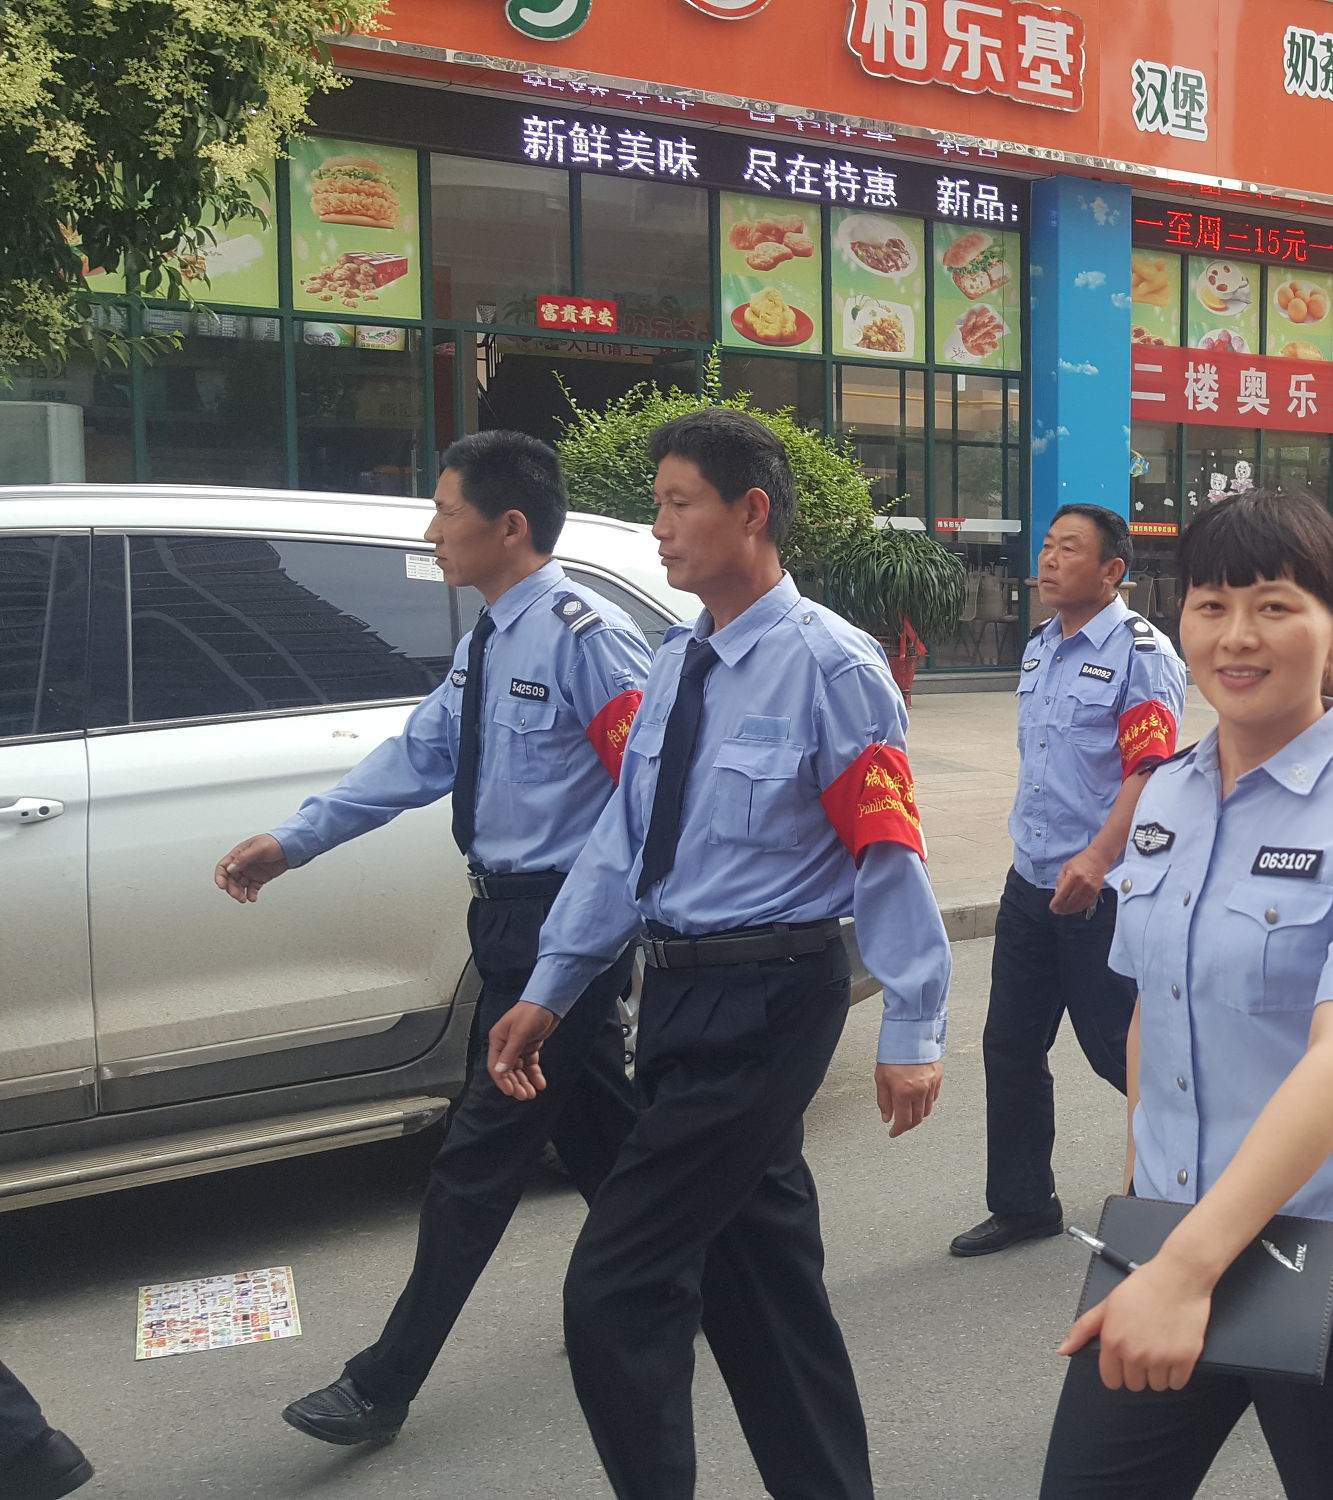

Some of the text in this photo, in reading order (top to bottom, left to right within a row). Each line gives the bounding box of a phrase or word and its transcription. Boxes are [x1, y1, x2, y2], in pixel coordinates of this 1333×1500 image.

[862, 0, 1076, 95] 柏乐基
[1134, 65, 1205, 137] 汉堡
[522, 115, 700, 181] 新鲜美味
[743, 147, 898, 208] 尽在特惠
[512, 681, 545, 697] 542509
[1082, 664, 1112, 680] BA0092
[1258, 852, 1317, 873] 063107
